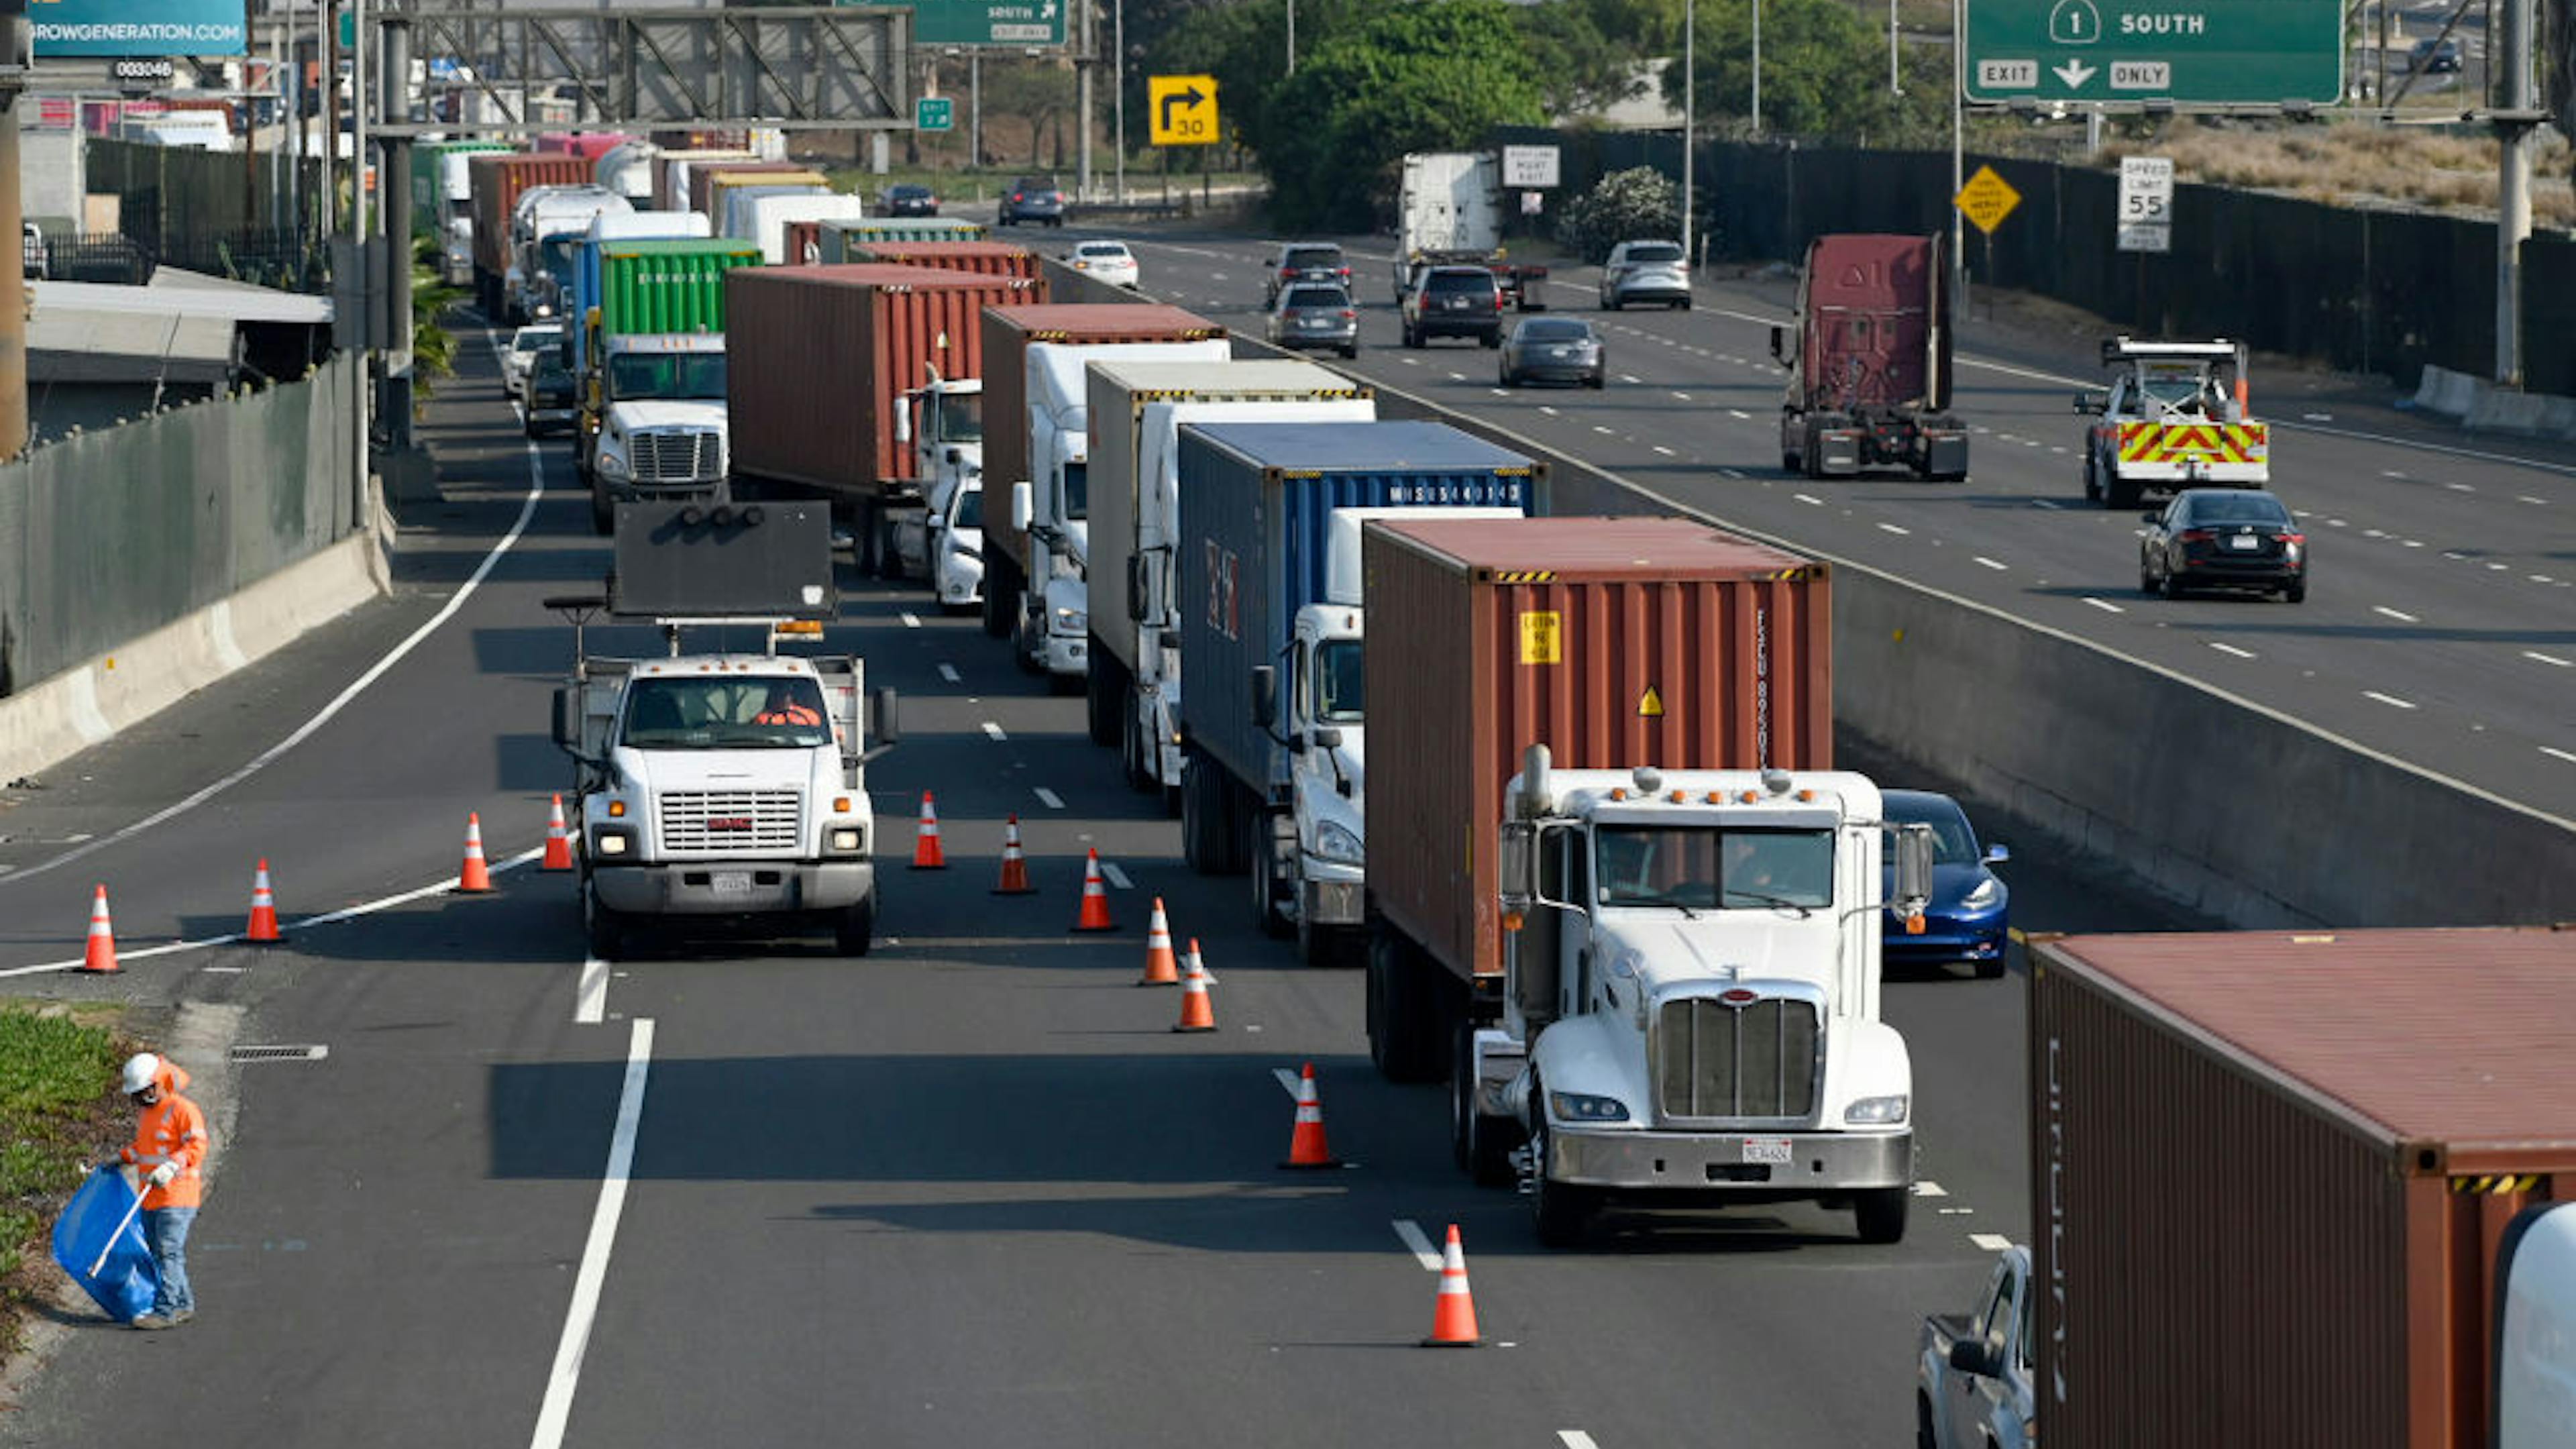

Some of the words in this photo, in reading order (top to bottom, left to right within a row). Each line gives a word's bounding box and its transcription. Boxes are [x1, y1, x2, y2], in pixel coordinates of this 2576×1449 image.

[2070, 11, 2080, 34] 1
[2121, 13, 2204, 34] SOUTH
[1986, 68, 2028, 81] EXIT
[2116, 68, 2164, 83] ONLY
[1177, 119, 1203, 136] 30
[2125, 163, 2169, 175] SPEED
[2130, 195, 2162, 215] 55
